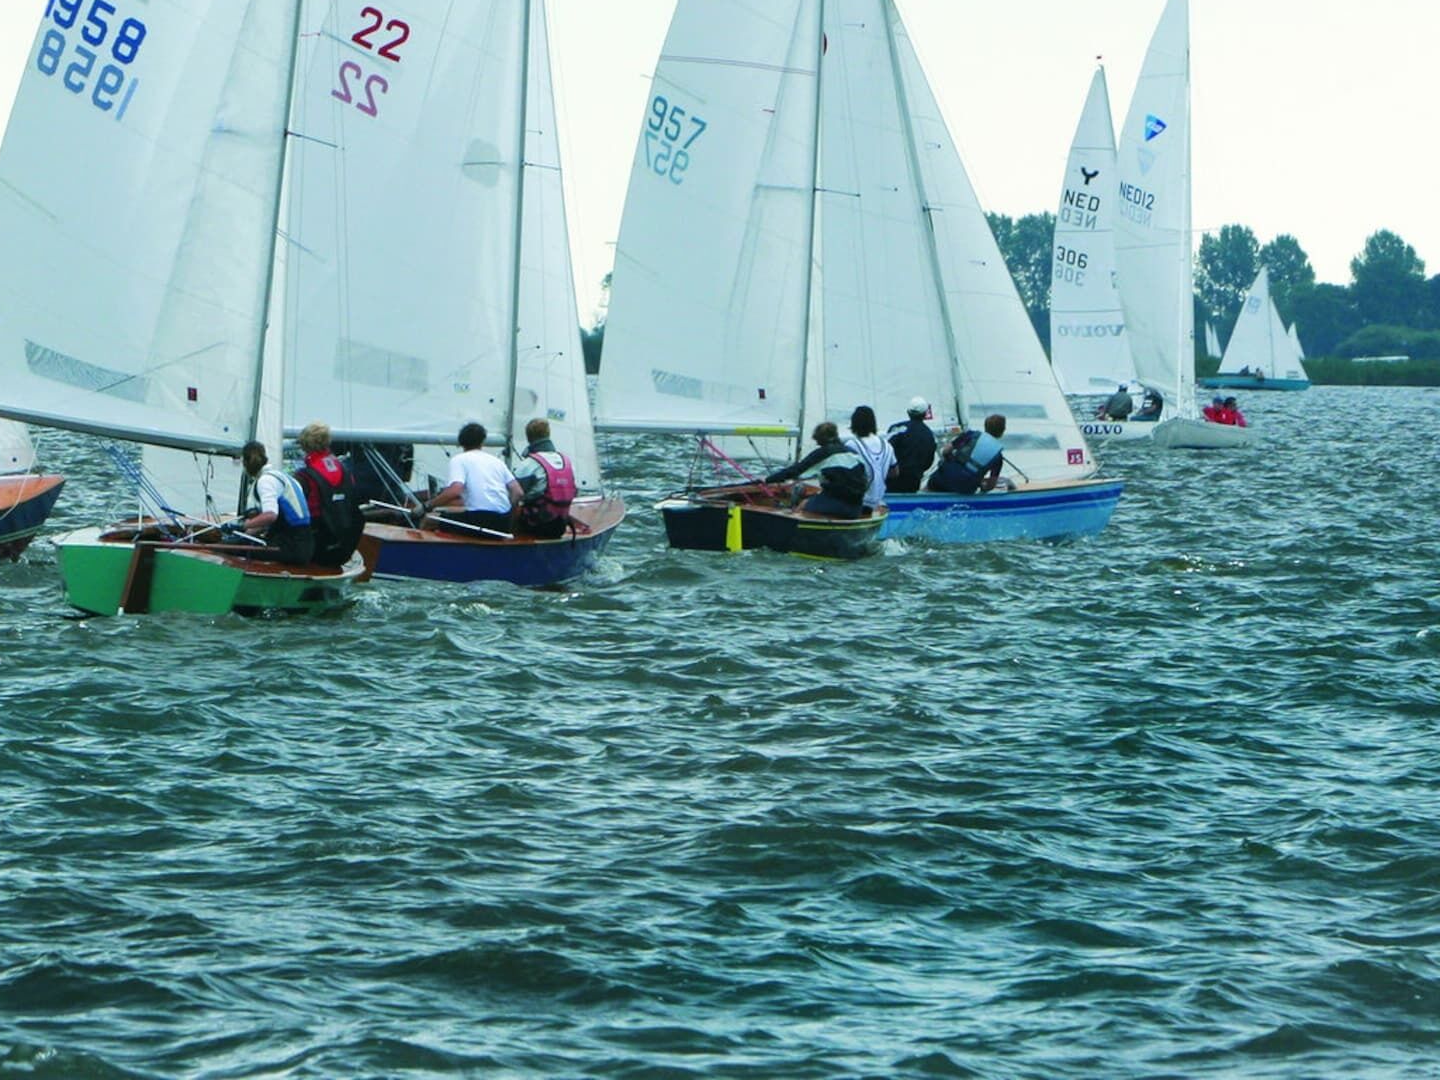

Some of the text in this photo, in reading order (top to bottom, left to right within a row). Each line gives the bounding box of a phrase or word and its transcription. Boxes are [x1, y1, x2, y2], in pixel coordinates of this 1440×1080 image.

[352, 7, 410, 62] 22
[648, 96, 707, 149] 957
[1064, 189, 1100, 212] NED
[1057, 246, 1088, 269] 306
